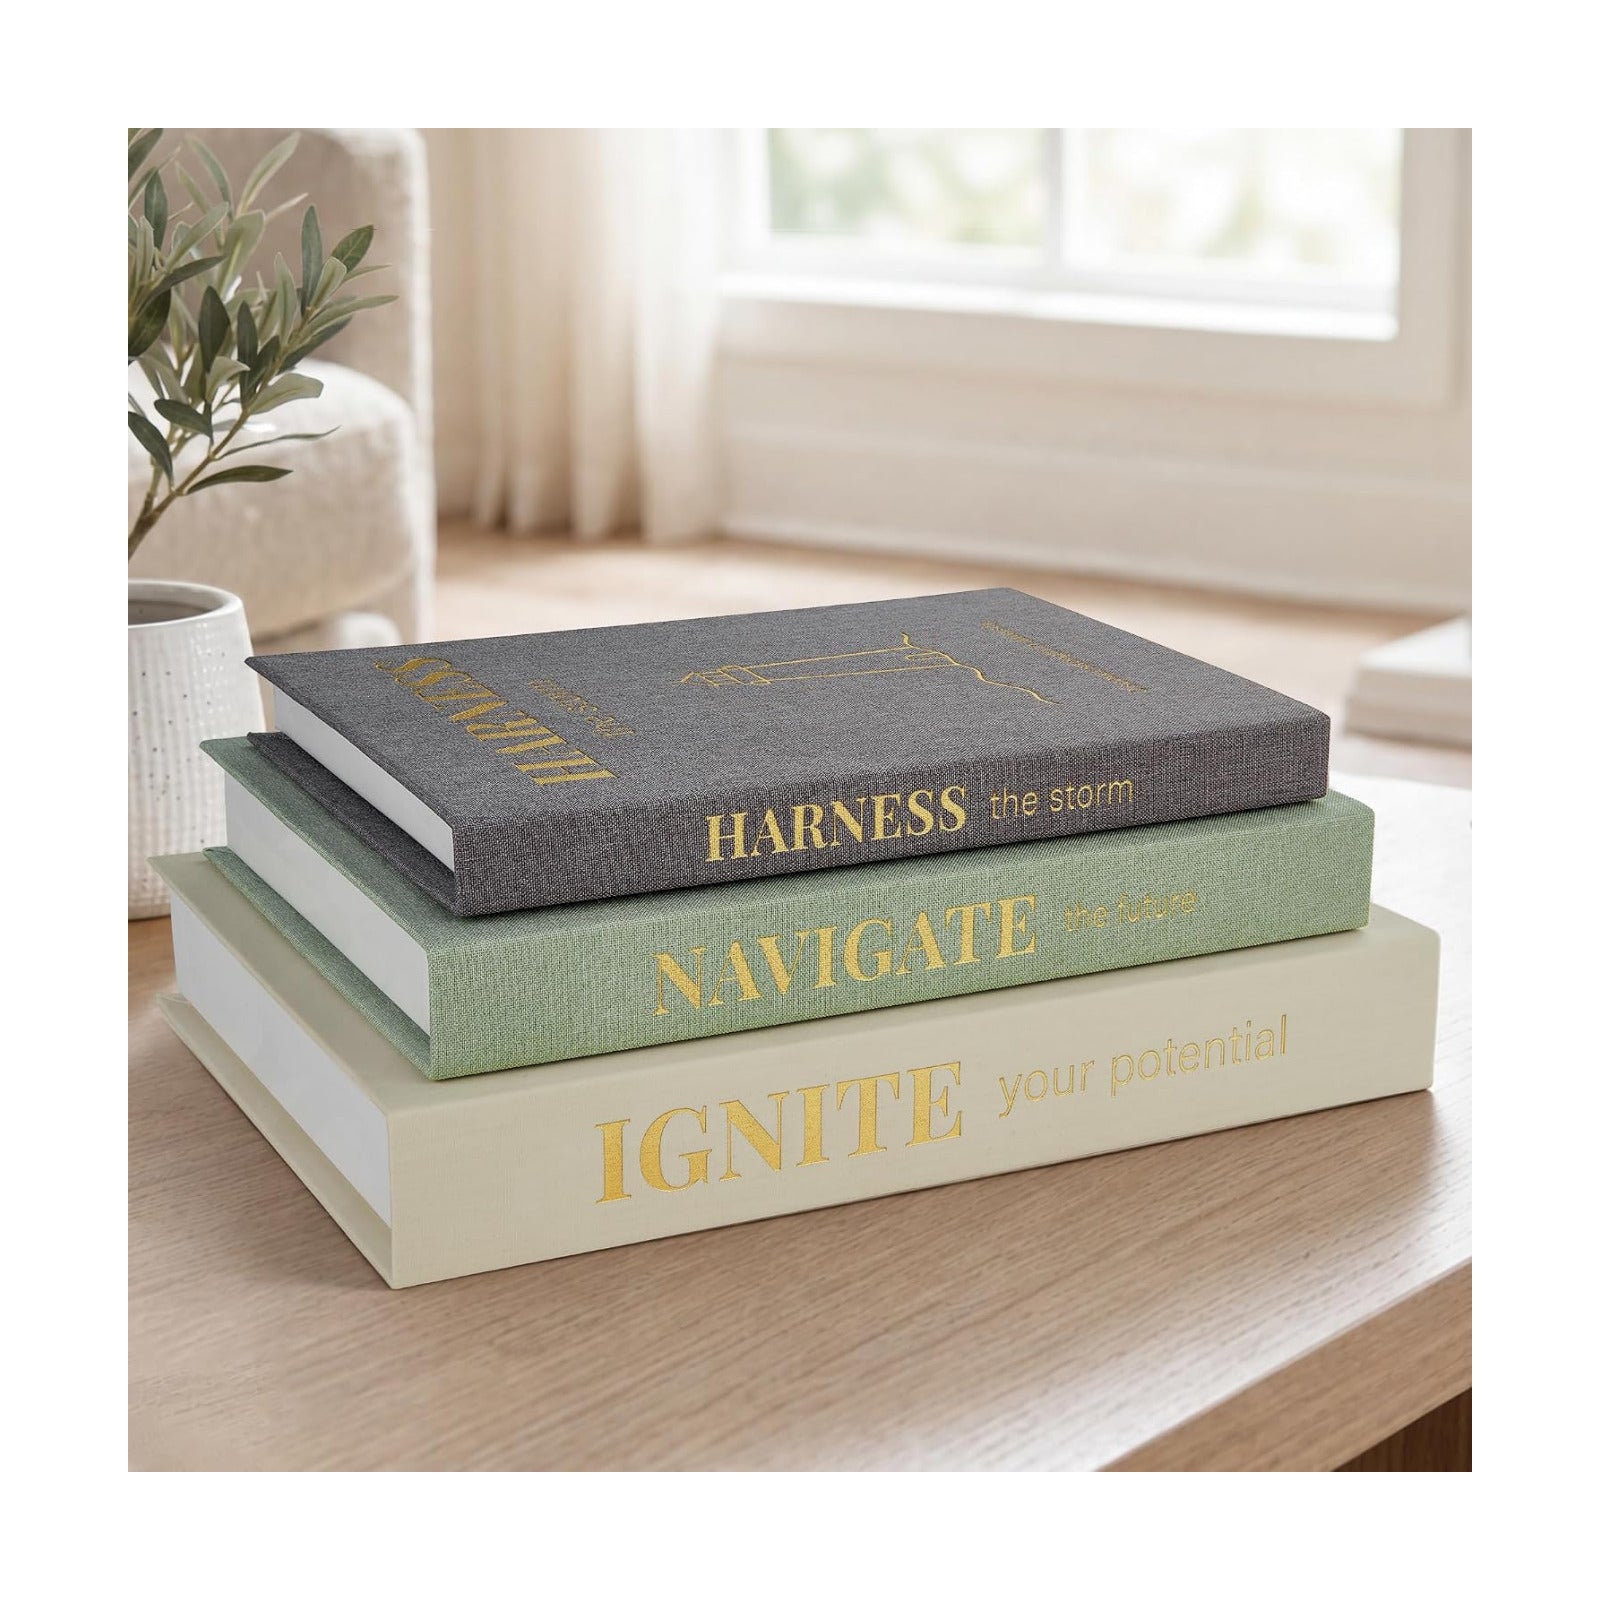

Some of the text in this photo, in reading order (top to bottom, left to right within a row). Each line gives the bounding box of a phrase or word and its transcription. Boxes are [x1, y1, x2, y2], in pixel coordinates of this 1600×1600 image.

[373, 656, 620, 786] HARNESS
[704, 776, 1135, 863] HARNESS the storm
[652, 887, 1198, 1018] NAVIGATE the future
[594, 1014, 1289, 1206] IGNITE your potential
